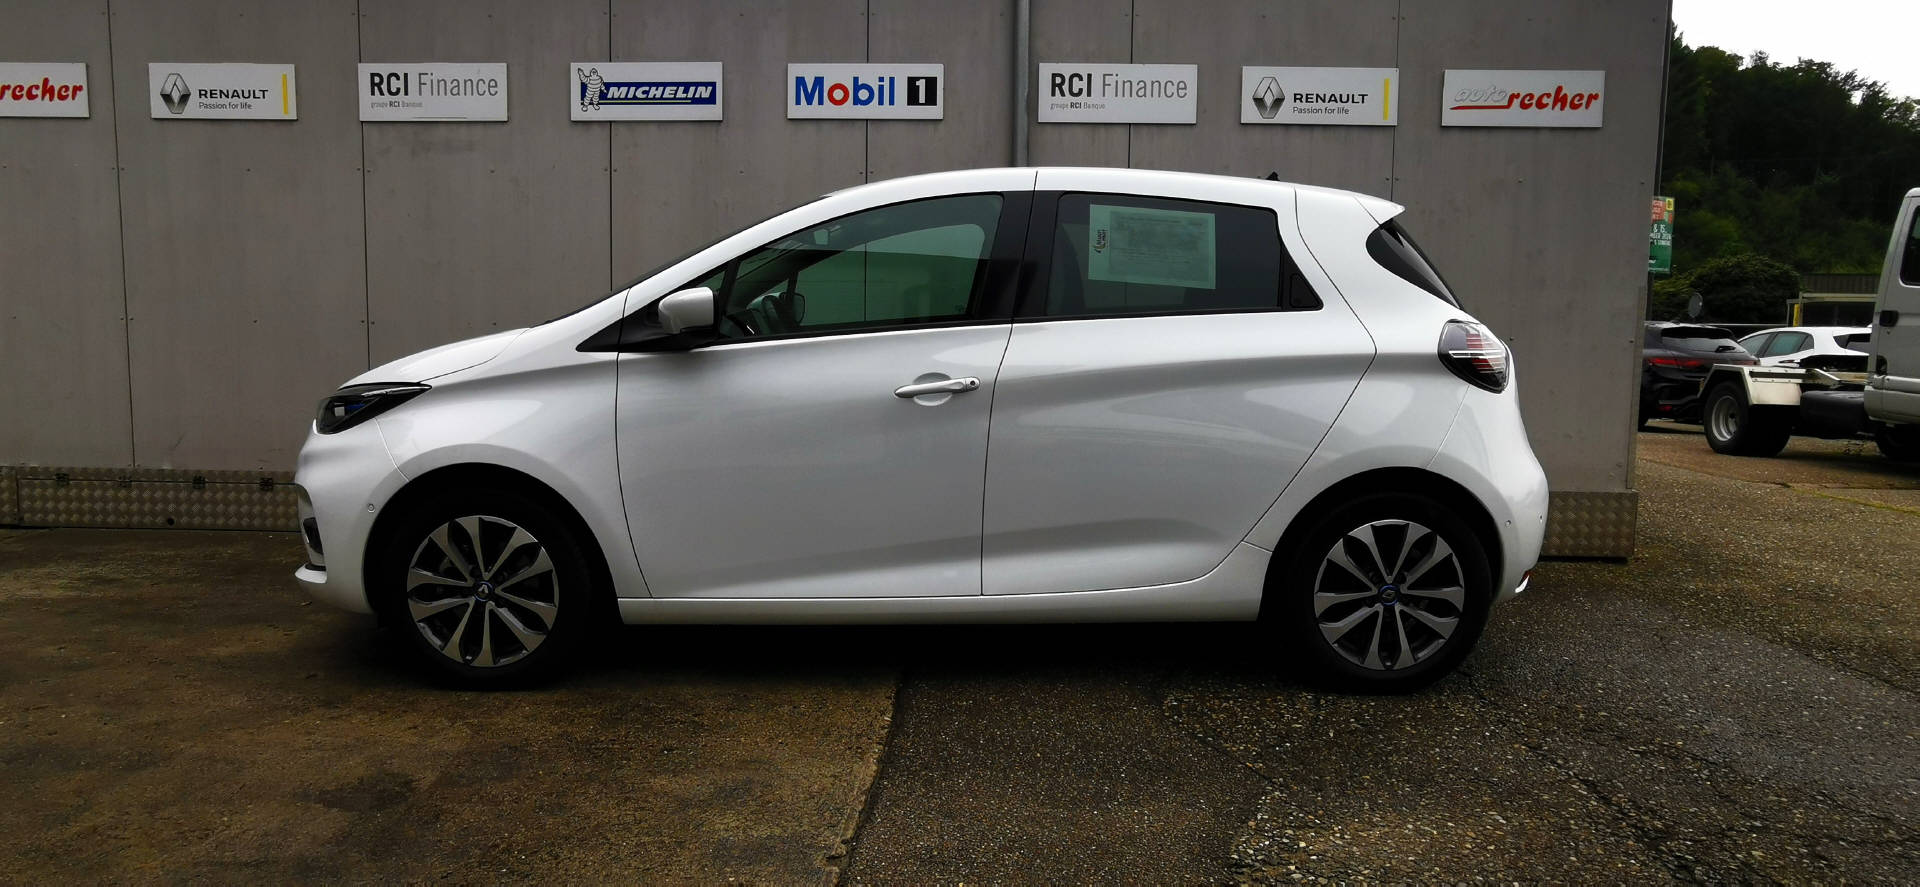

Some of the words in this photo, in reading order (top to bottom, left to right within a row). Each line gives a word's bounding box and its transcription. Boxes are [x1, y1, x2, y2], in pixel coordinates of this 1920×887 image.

[370, 72, 409, 96] RCI
[418, 73, 498, 96] Finance
[1050, 73, 1093, 97] RCI
[1102, 73, 1187, 98] Finance
[199, 89, 268, 100] RENAULT
[607, 86, 712, 98] MICHELIN
[795, 76, 895, 106] Mobil
[916, 79, 926, 103] 1
[1293, 92, 1368, 104] RENAULT
[199, 102, 227, 110] Passion
[229, 102, 240, 110] for
[242, 102, 252, 110] life
[1293, 106, 1323, 115] Passion
[1324, 106, 1337, 115] for
[1339, 106, 1349, 115] life
